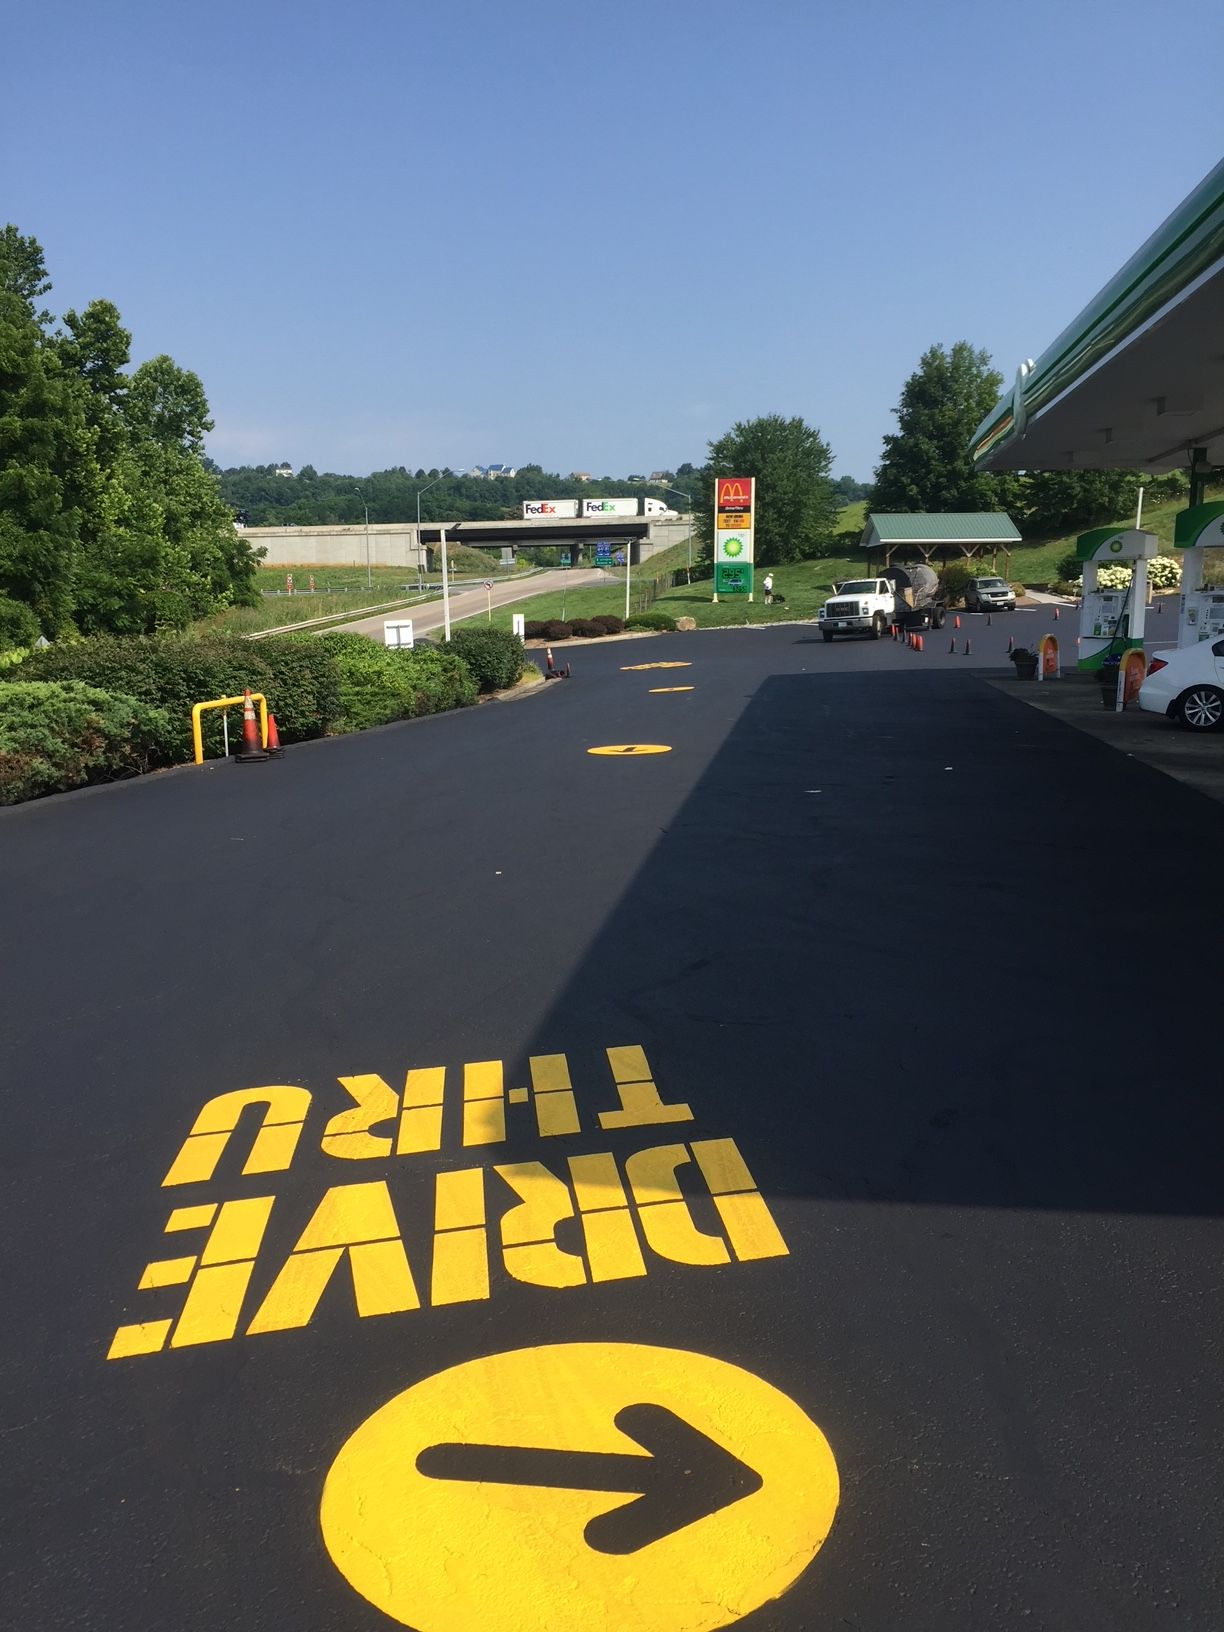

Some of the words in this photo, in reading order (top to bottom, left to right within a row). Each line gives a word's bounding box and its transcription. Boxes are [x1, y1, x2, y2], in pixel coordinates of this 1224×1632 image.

[525, 503, 556, 514] FedEx
[586, 502, 616, 512] FedEx
[161, 1045, 694, 1187] THRU
[106, 1137, 790, 1360] DRIVE
